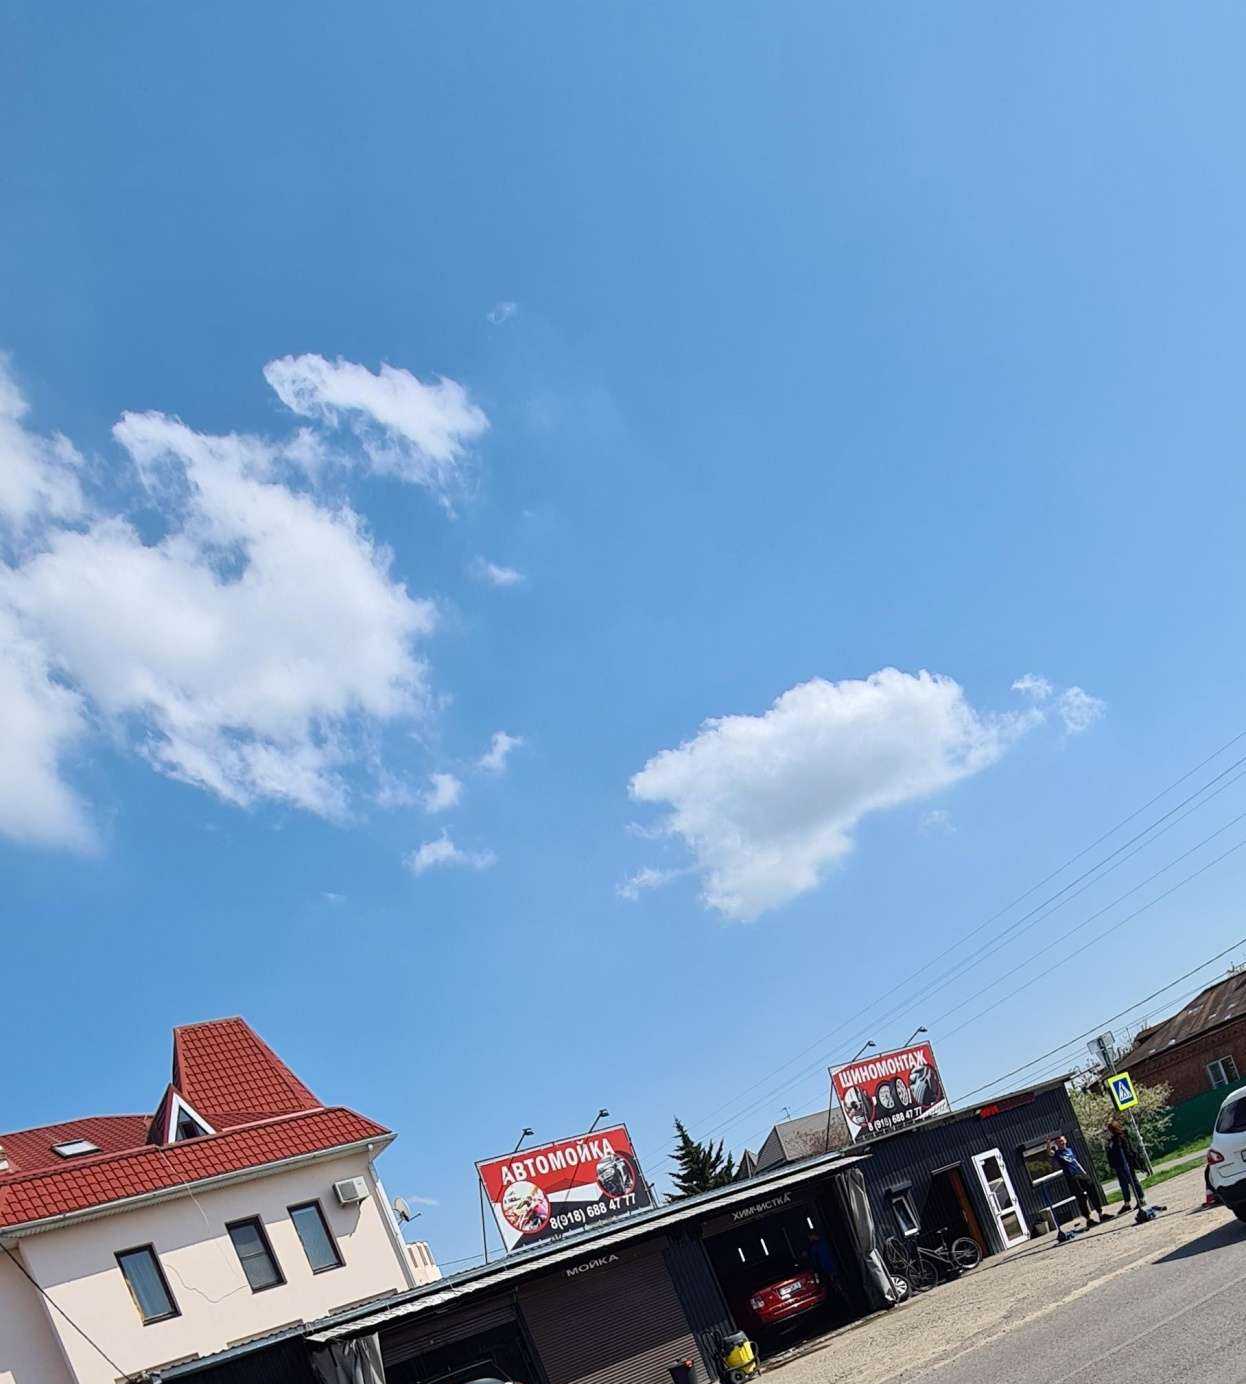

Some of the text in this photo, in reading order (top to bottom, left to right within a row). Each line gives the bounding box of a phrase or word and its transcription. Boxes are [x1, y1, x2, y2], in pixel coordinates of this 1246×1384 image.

[838, 1050, 927, 1088] ШИНОМОНТАЖ
[868, 1106, 922, 1131] 8 (918) 688 47 77
[501, 1138, 615, 1186] АВТОМОЙКА
[550, 1193, 636, 1230] 8(918) 688 47 77
[731, 1191, 792, 1220] ХИМЧИСТКА
